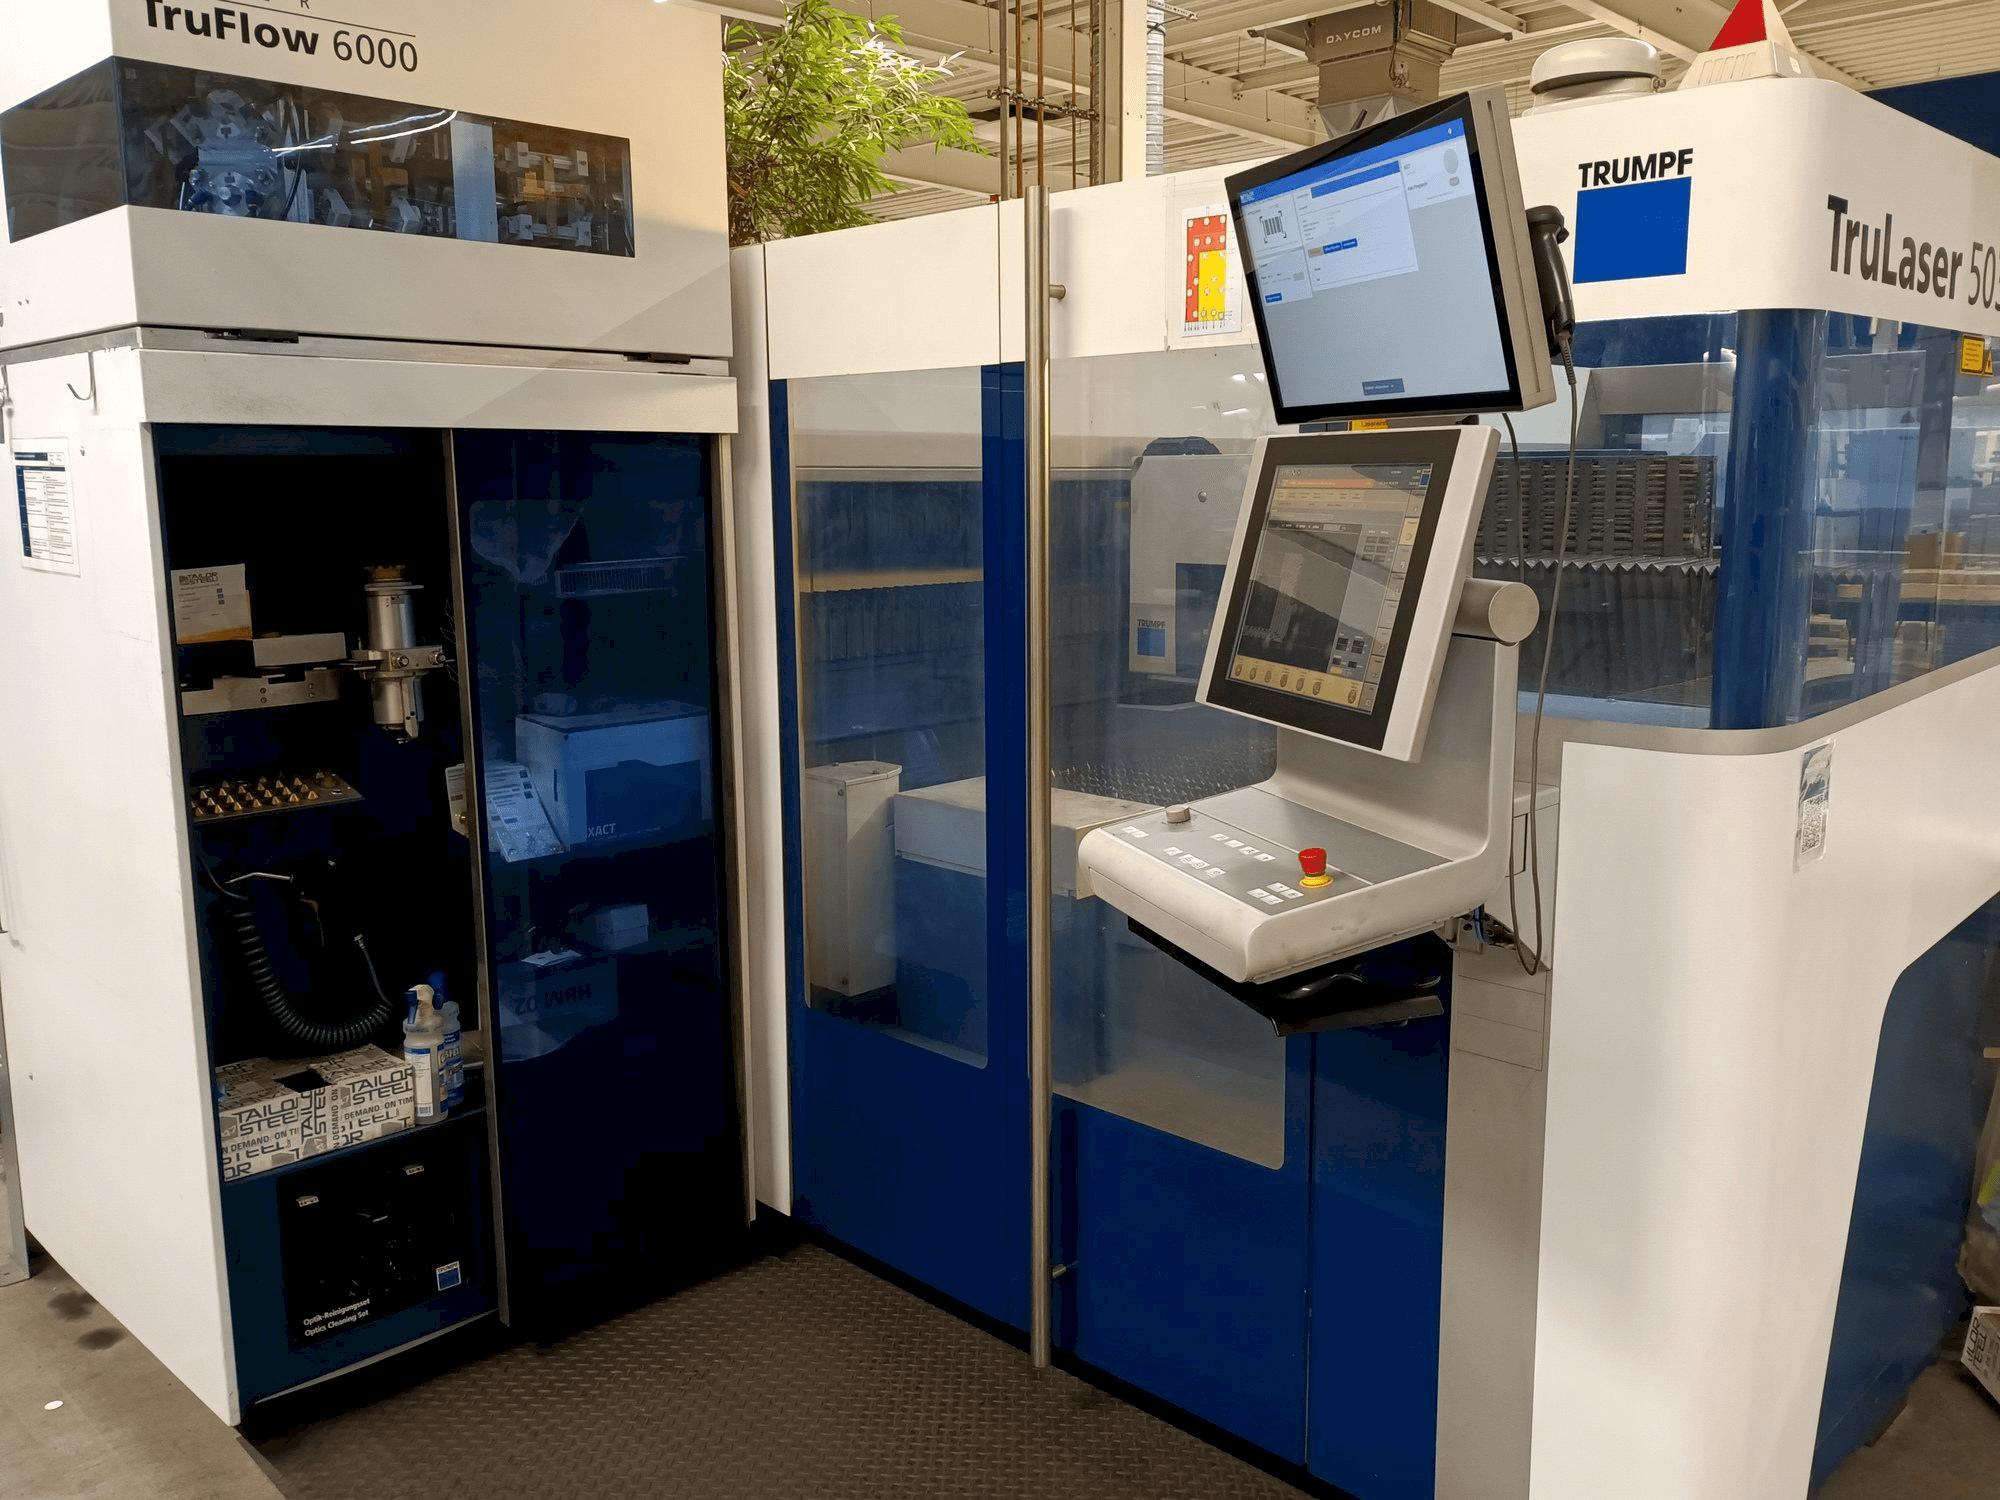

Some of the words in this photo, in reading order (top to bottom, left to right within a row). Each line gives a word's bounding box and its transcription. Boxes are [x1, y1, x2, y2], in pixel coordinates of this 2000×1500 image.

[146, 0, 319, 55] TruFlow
[333, 30, 418, 73] 6000
[1578, 148, 1693, 188] TRUMPF
[1828, 194, 1963, 300] TruLaser
[1968, 241, 2000, 312] 50
[1137, 619, 1166, 628] TRUMPF
[353, 1080, 413, 1105] STEEL
[344, 1105, 380, 1120] DEMAND
[384, 1100, 396, 1109] ON
[398, 1096, 413, 1105] TIM
[332, 1105, 340, 1140] DEMAND
[231, 1135, 269, 1152] DEMAND
[274, 1130, 287, 1139] ON
[305, 1325, 326, 1336] Optics
[327, 1314, 357, 1329] Cleaning
[357, 1309, 369, 1319] Set
